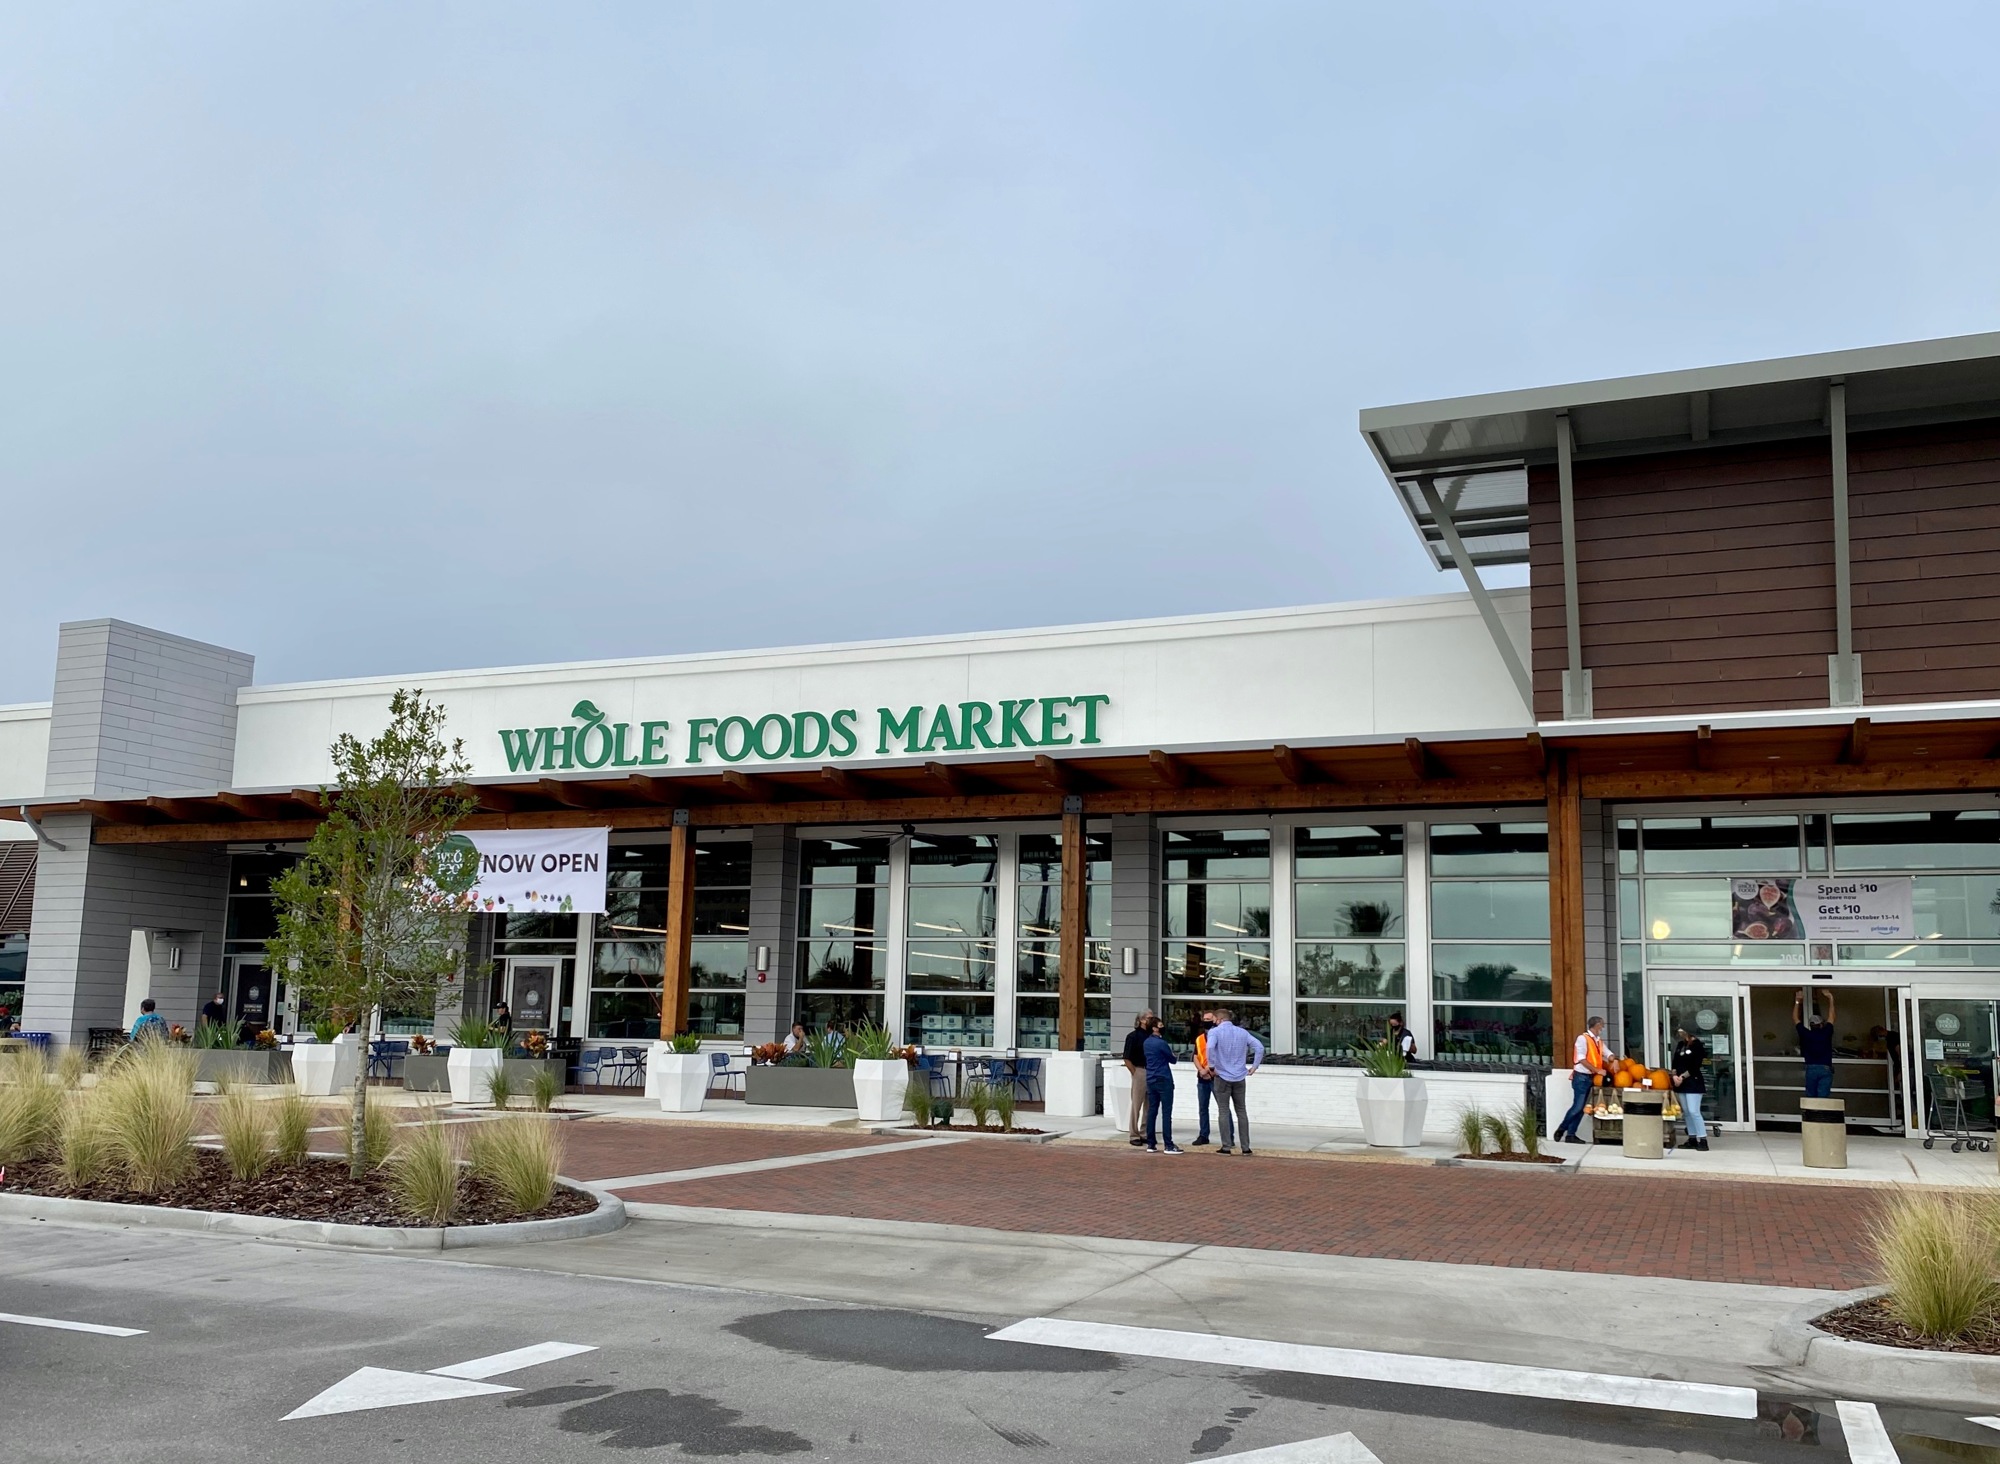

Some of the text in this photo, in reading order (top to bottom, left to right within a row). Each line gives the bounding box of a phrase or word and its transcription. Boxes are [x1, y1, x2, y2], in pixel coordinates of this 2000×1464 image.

[499, 694, 1110, 772] WHOLE FOODS MARKET
[483, 853, 599, 874] NOW OPEN
[1817, 883, 1878, 896] Spend $10
[1818, 904, 1861, 914] Get $10
